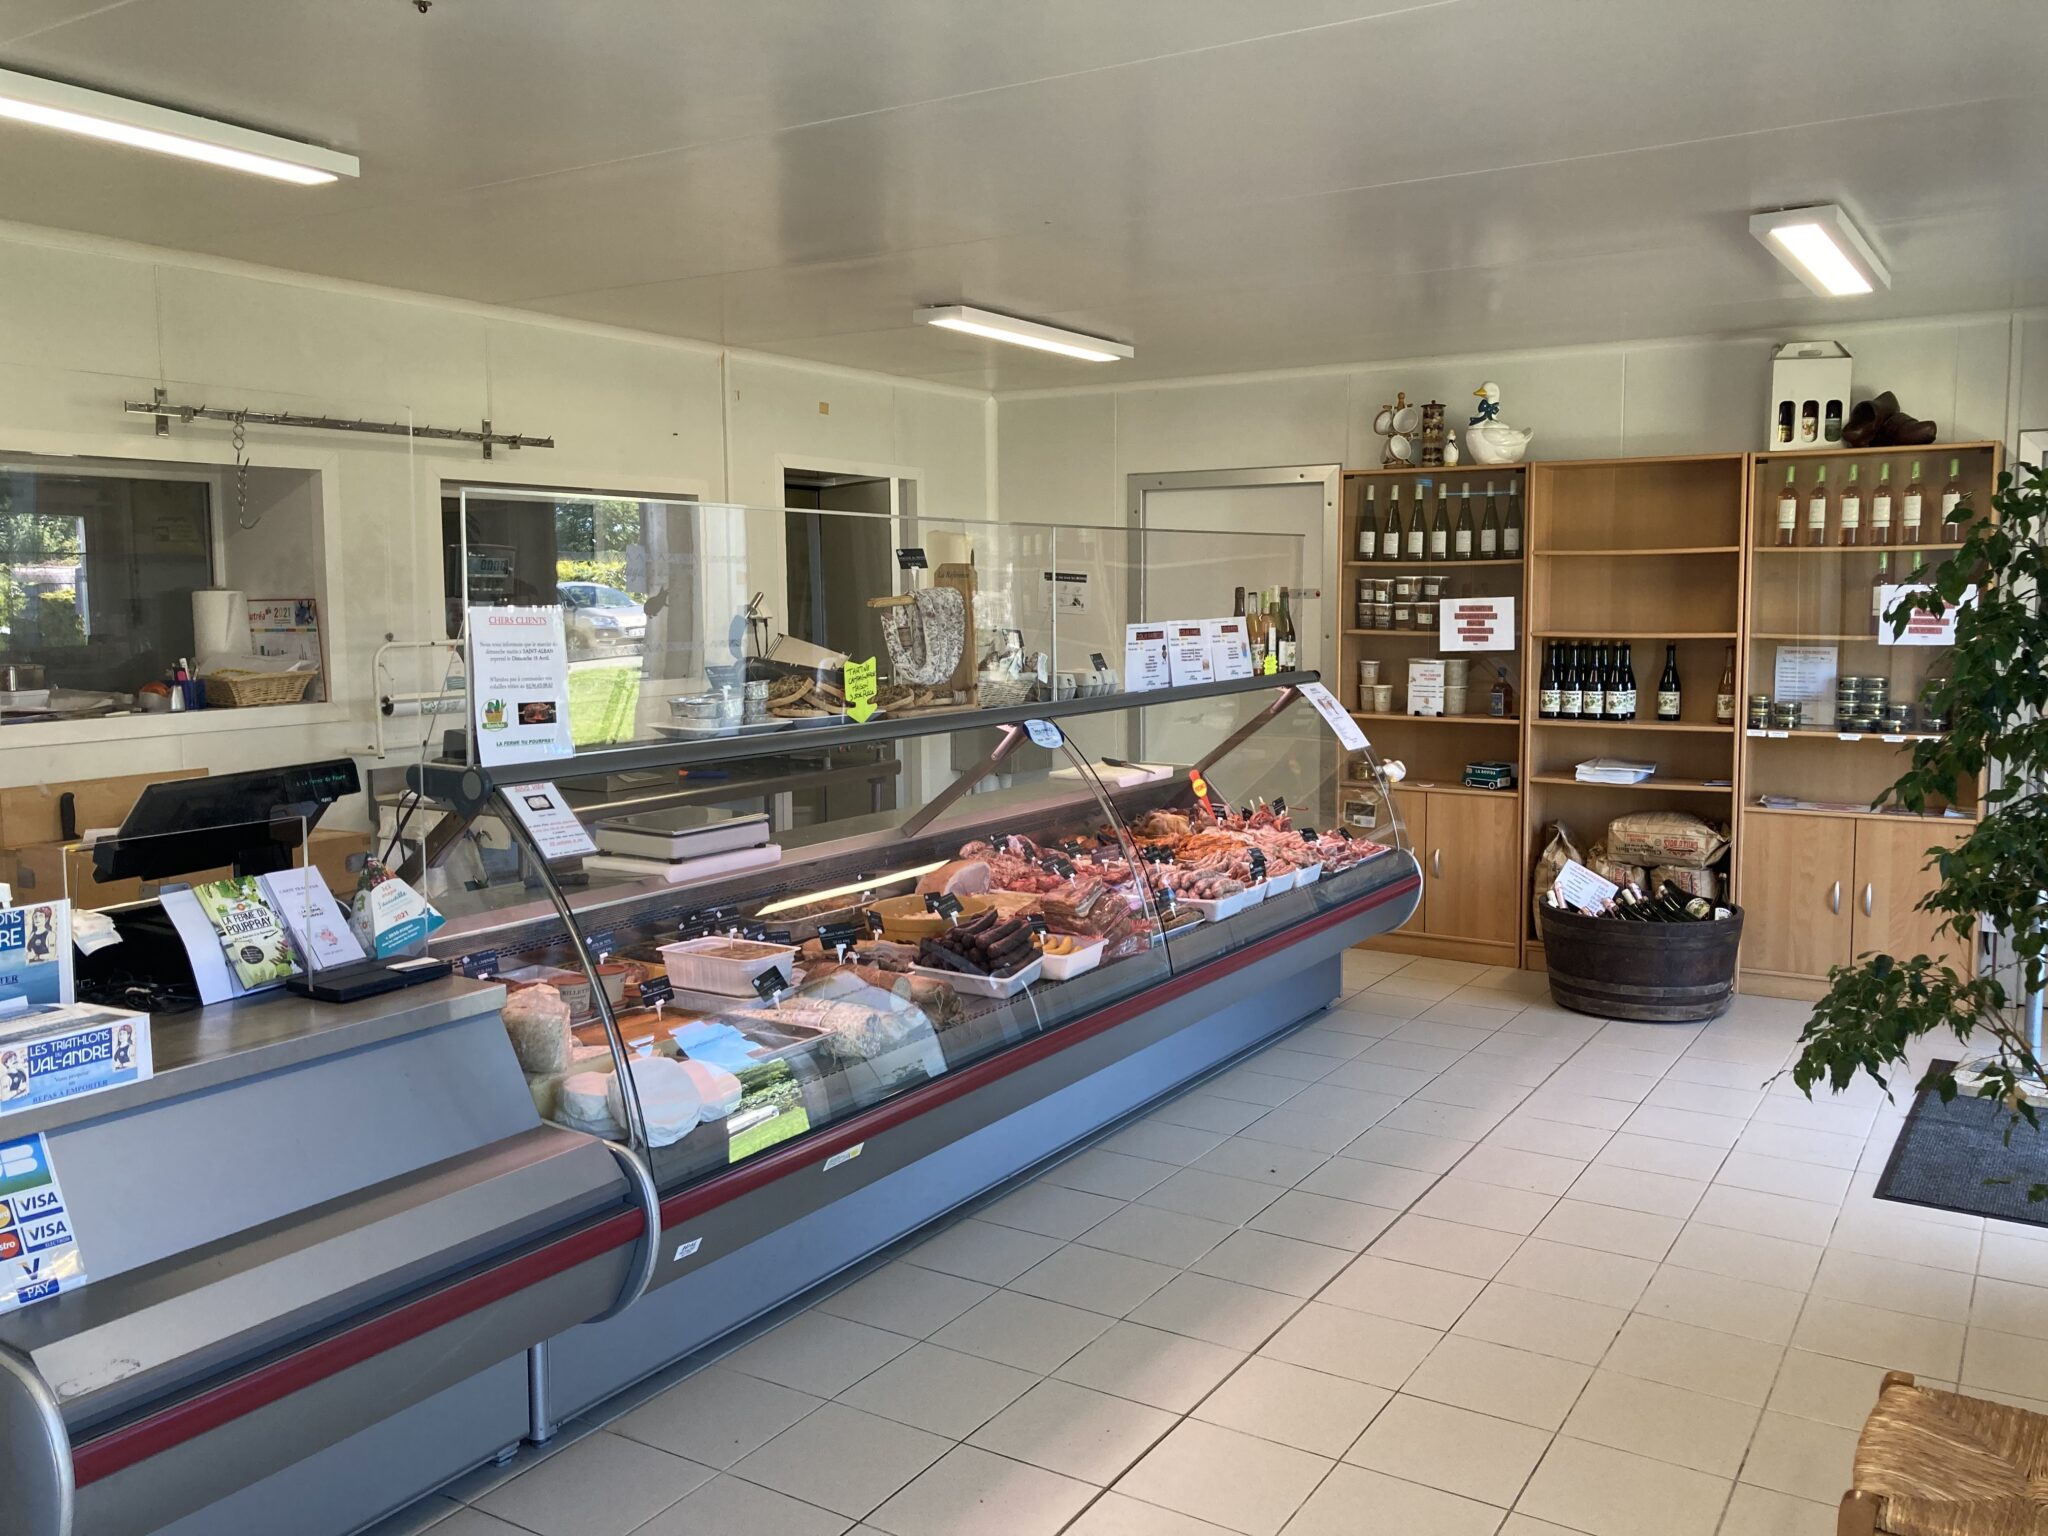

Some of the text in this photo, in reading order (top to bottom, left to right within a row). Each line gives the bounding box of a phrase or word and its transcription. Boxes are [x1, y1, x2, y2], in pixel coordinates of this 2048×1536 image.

[274, 607, 291, 618] 2021
[489, 616, 547, 625] CHERS CLIENTS
[222, 908, 268, 926] LA FERME DU
[226, 916, 272, 935] POURPRAY
[393, 911, 409, 922] 2021
[30, 1030, 110, 1057] LES TRIATHLONS
[30, 1043, 111, 1075] VAL-ANDRE
[32, 1091, 57, 1104] REPAS
[66, 1080, 108, 1096] EMPORTER
[20, 1192, 58, 1211] VISA
[28, 1221, 67, 1241] VISA
[45, 1236, 71, 1248] ELECTRON
[18, 1257, 40, 1281] V
[26, 1281, 51, 1299] PAY
